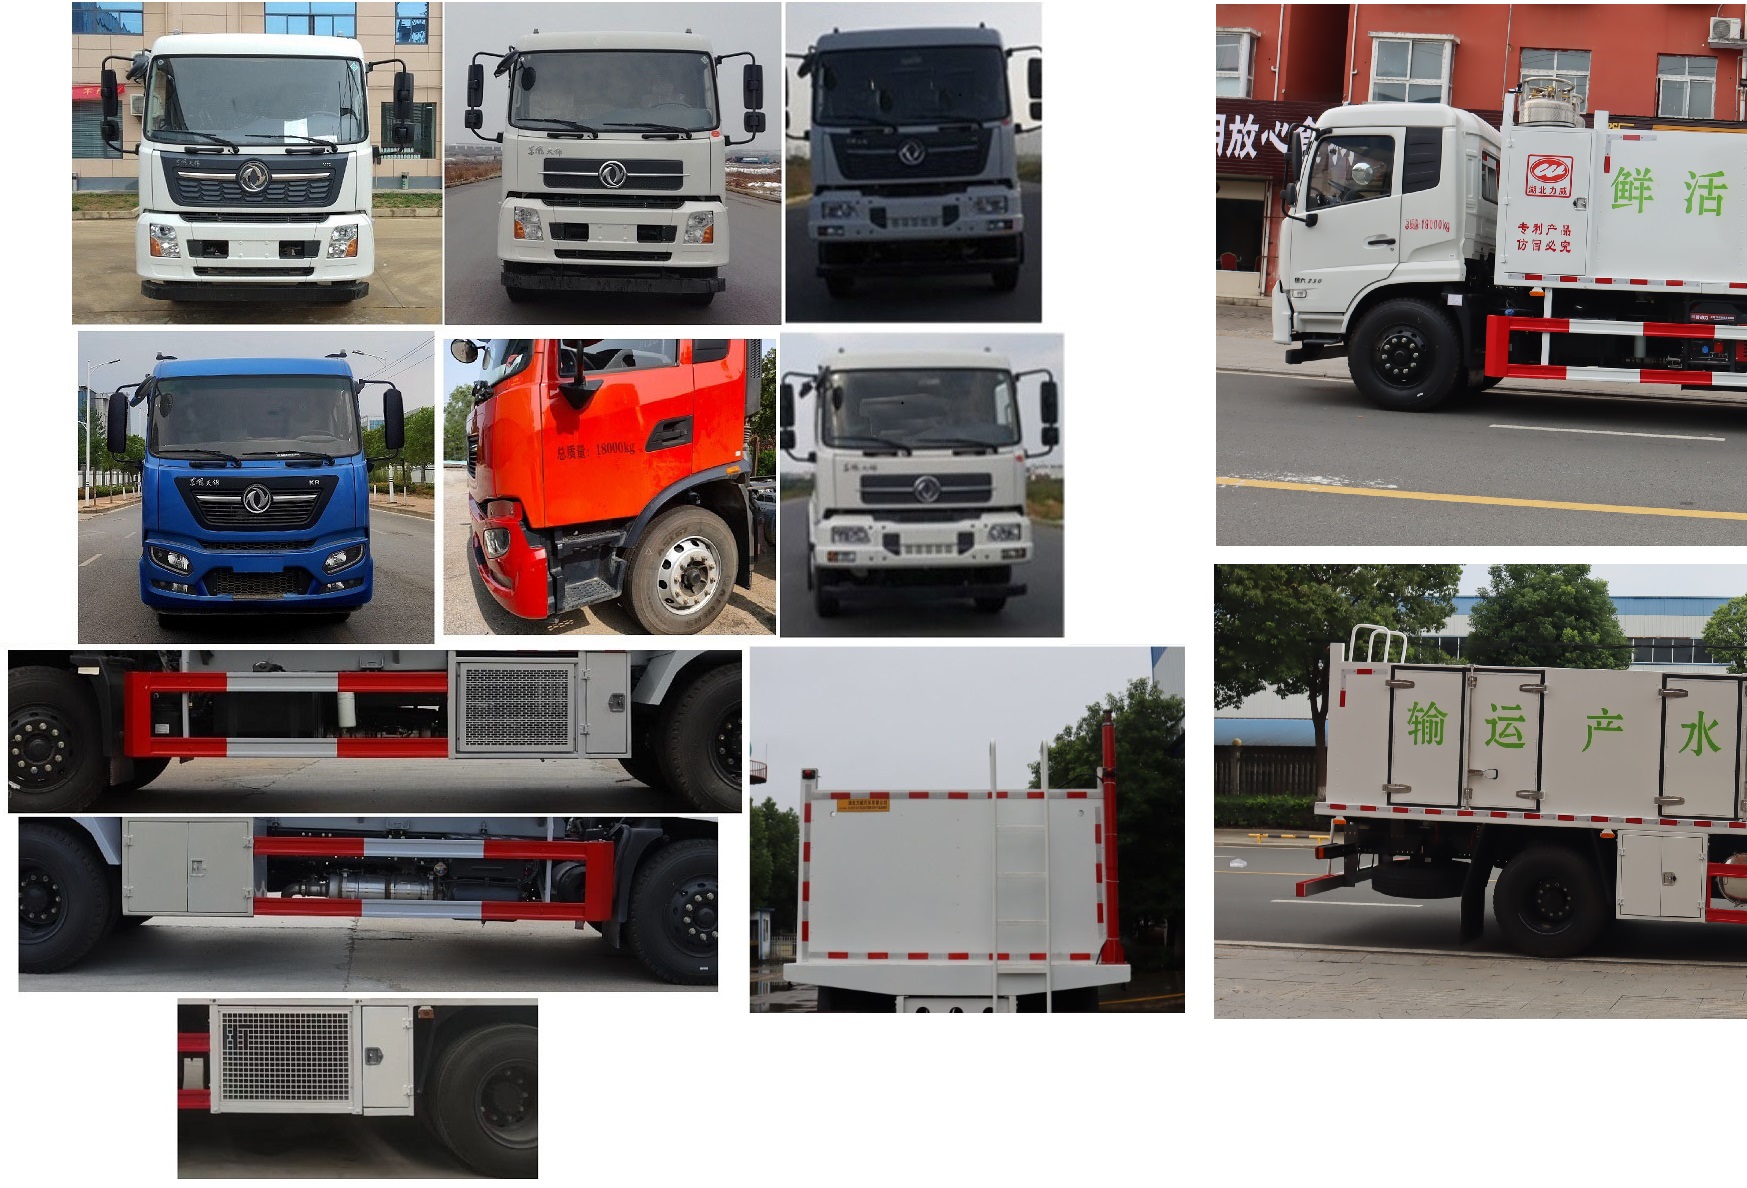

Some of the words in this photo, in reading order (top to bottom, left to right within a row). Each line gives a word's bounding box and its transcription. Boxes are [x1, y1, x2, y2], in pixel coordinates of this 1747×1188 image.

[1528, 186, 1568, 196] 湖北力威
[1517, 222, 1571, 236] 专利产品
[1517, 239, 1571, 253] 仿冒必究
